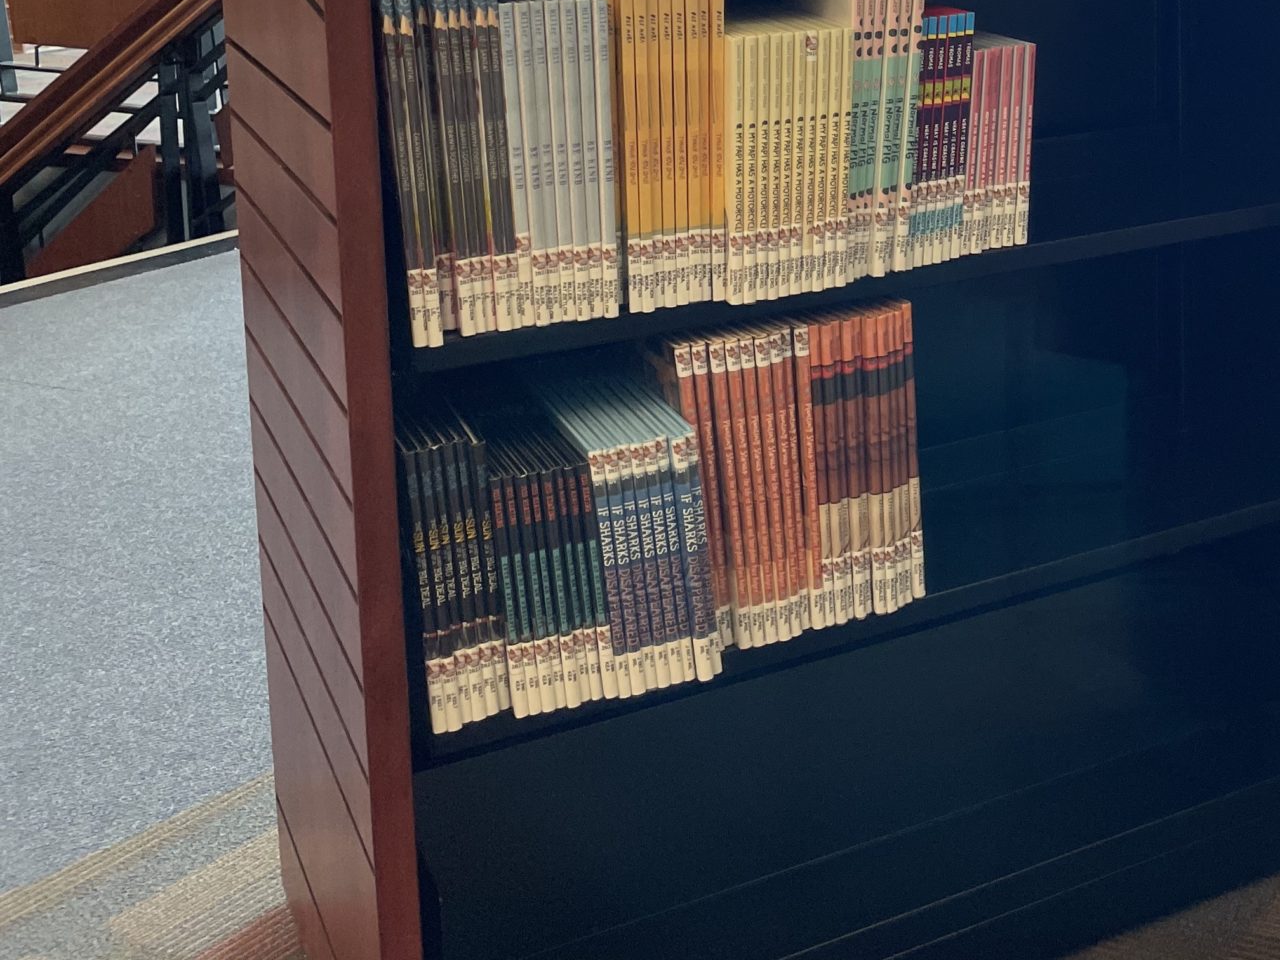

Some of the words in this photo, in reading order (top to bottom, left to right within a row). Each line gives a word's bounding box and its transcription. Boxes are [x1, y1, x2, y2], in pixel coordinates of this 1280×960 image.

[882, 145, 892, 164] PIG
[639, 499, 649, 509] IF
[651, 496, 662, 506] IF
[681, 494, 692, 504] IF
[598, 507, 609, 517] IF
[640, 514, 654, 559] SHARKS
[653, 510, 667, 555] SHARKS
[683, 508, 697, 553] SHARKS
[600, 522, 615, 567] SHARKS
